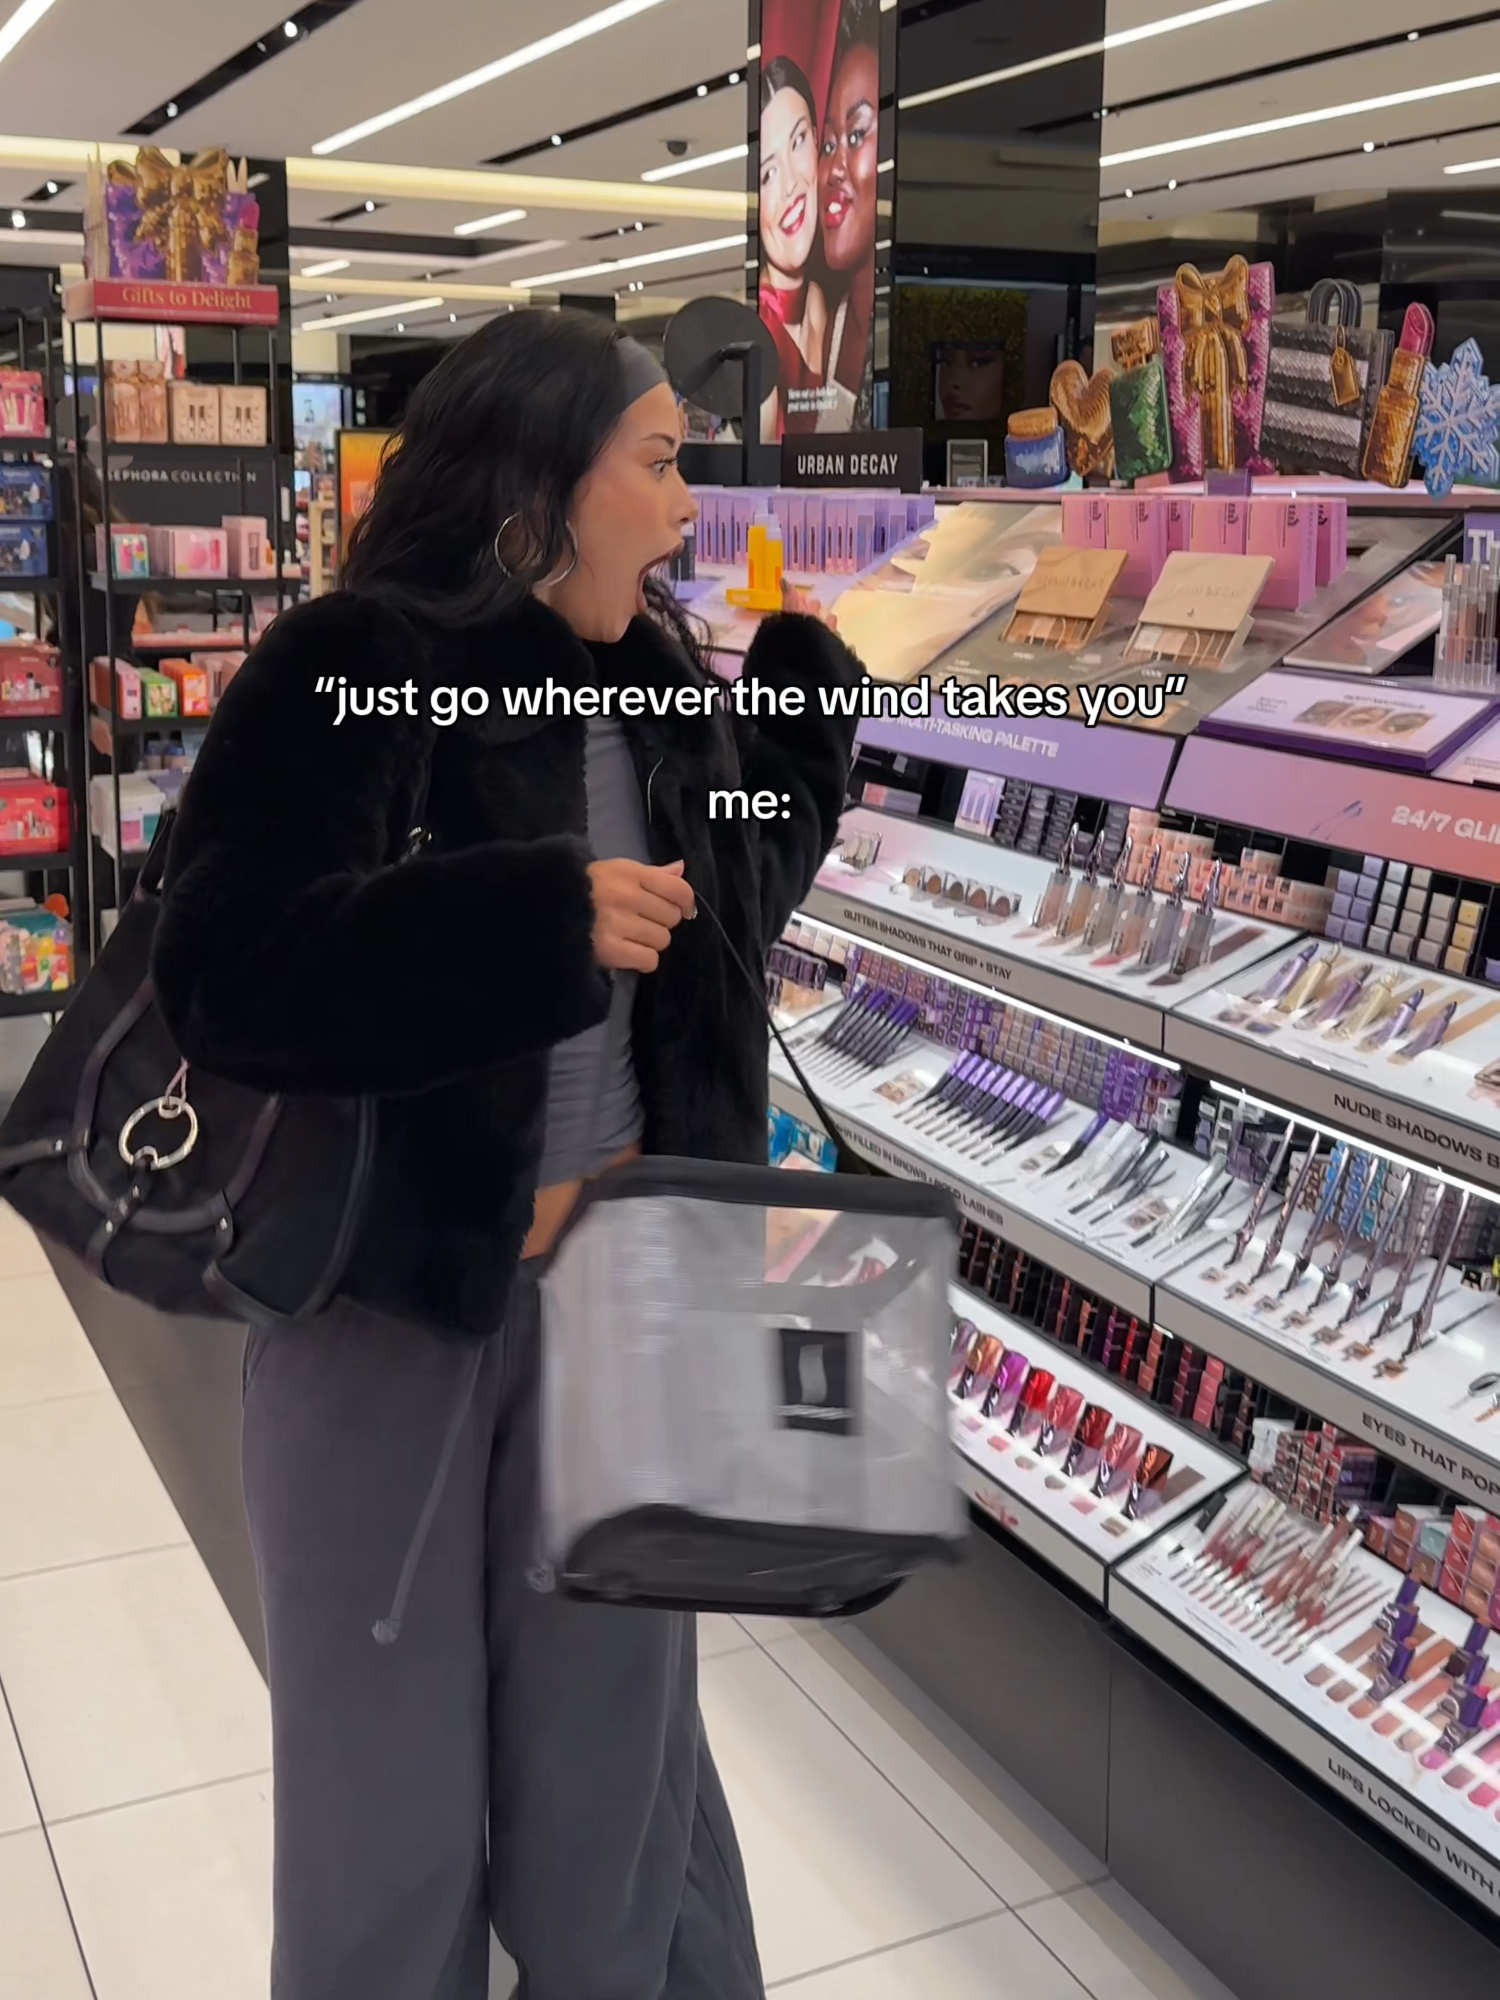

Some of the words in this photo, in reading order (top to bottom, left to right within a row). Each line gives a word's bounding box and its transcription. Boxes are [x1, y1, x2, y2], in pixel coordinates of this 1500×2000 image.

[122, 286, 165, 305] Gifts
[169, 290, 187, 306] to
[192, 290, 252, 309] Delight
[797, 454, 844, 475] URBAN
[850, 453, 898, 475] DECAY
[994, 730, 1059, 758] PALETTE
[1391, 805, 1452, 833] 24/7
[843, 908, 878, 931] GLITTER
[879, 923, 926, 945] SHADOWS
[928, 940, 952, 958] THAT
[953, 951, 977, 965] GRIP
[986, 962, 1012, 981] STAY
[1334, 1093, 1382, 1124] NUDE
[1385, 1114, 1482, 1163] SHADOWS
[1362, 1412, 1406, 1447] EYES
[1410, 1437, 1458, 1474] THAT
[1327, 1757, 1364, 1795] LIPS
[1367, 1787, 1441, 1852] LOCKED
[1444, 1845, 1494, 1895] WITH
